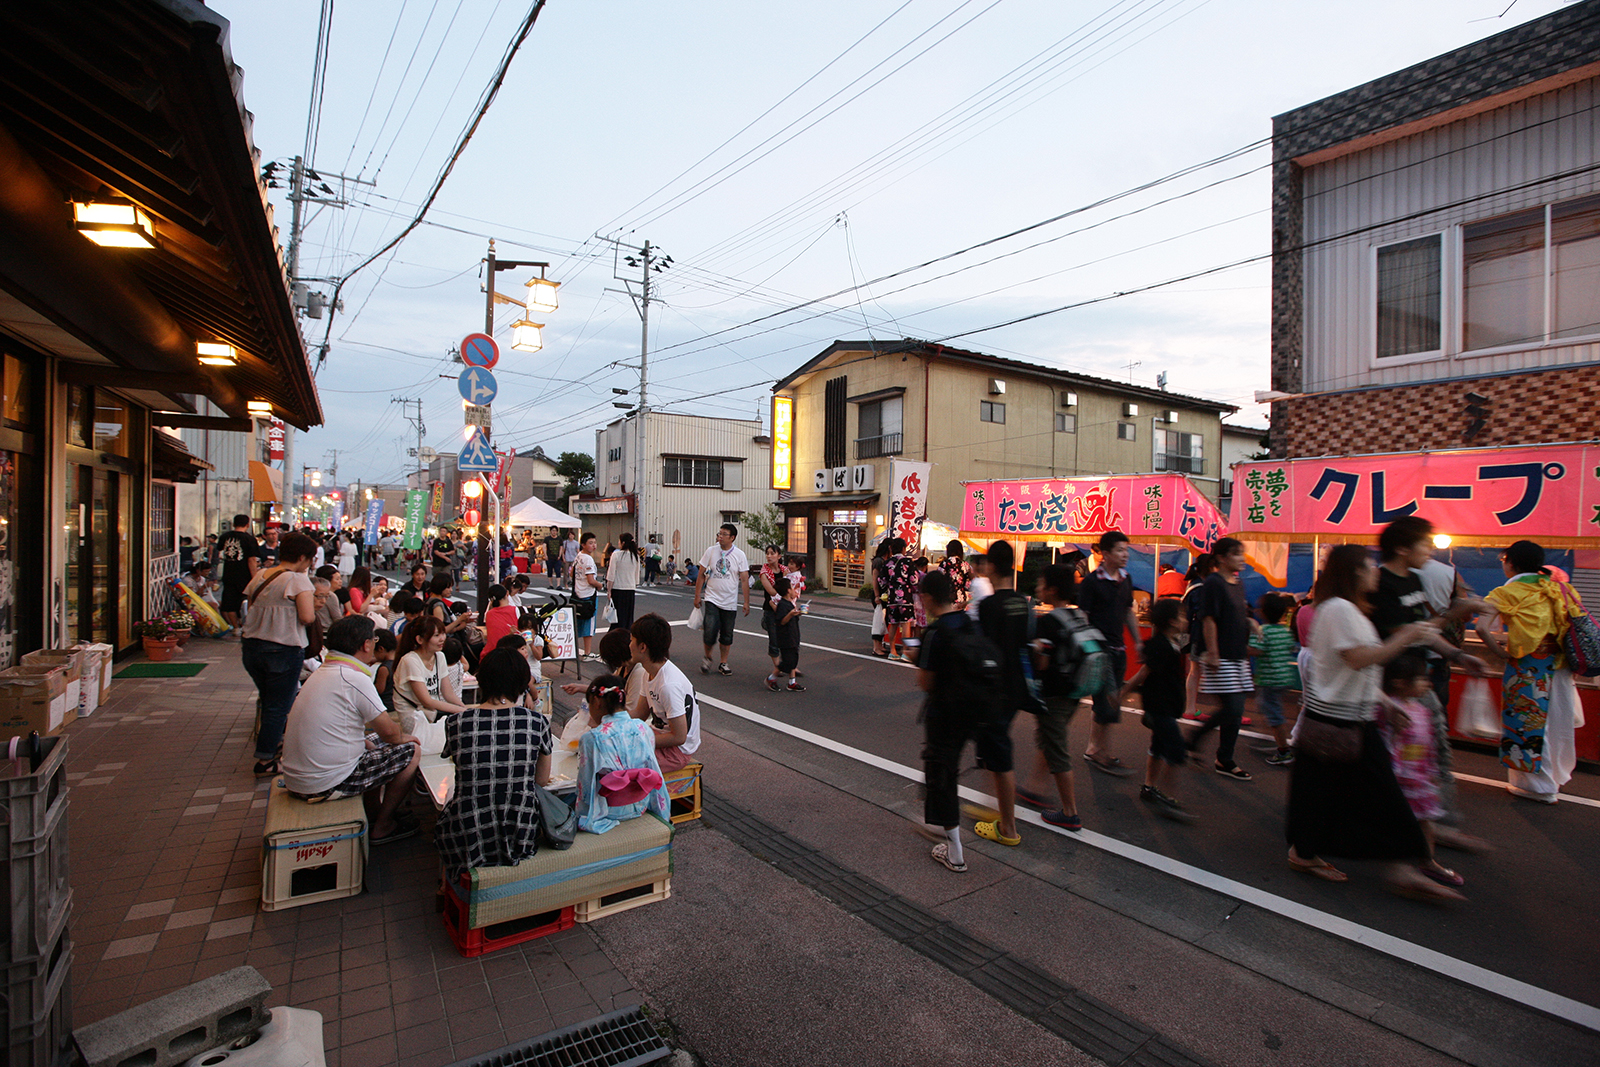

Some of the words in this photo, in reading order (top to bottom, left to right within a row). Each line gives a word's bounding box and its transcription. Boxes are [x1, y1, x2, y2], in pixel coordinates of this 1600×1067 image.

[816, 466, 865, 489] こばり
[1001, 483, 1076, 496] 大阪名物
[1245, 468, 1266, 524] 売る店
[1265, 467, 1289, 517] 夢を
[1308, 461, 1566, 526] クレープ
[367, 501, 380, 543] キッズコーナー
[409, 493, 423, 546] キッズコーナー
[898, 472, 921, 546] かき氷
[972, 489, 986, 527] 味自慢
[998, 493, 1068, 532] たこ焼
[1142, 484, 1163, 530] 味自慢
[296, 844, 334, 862] Asahi
